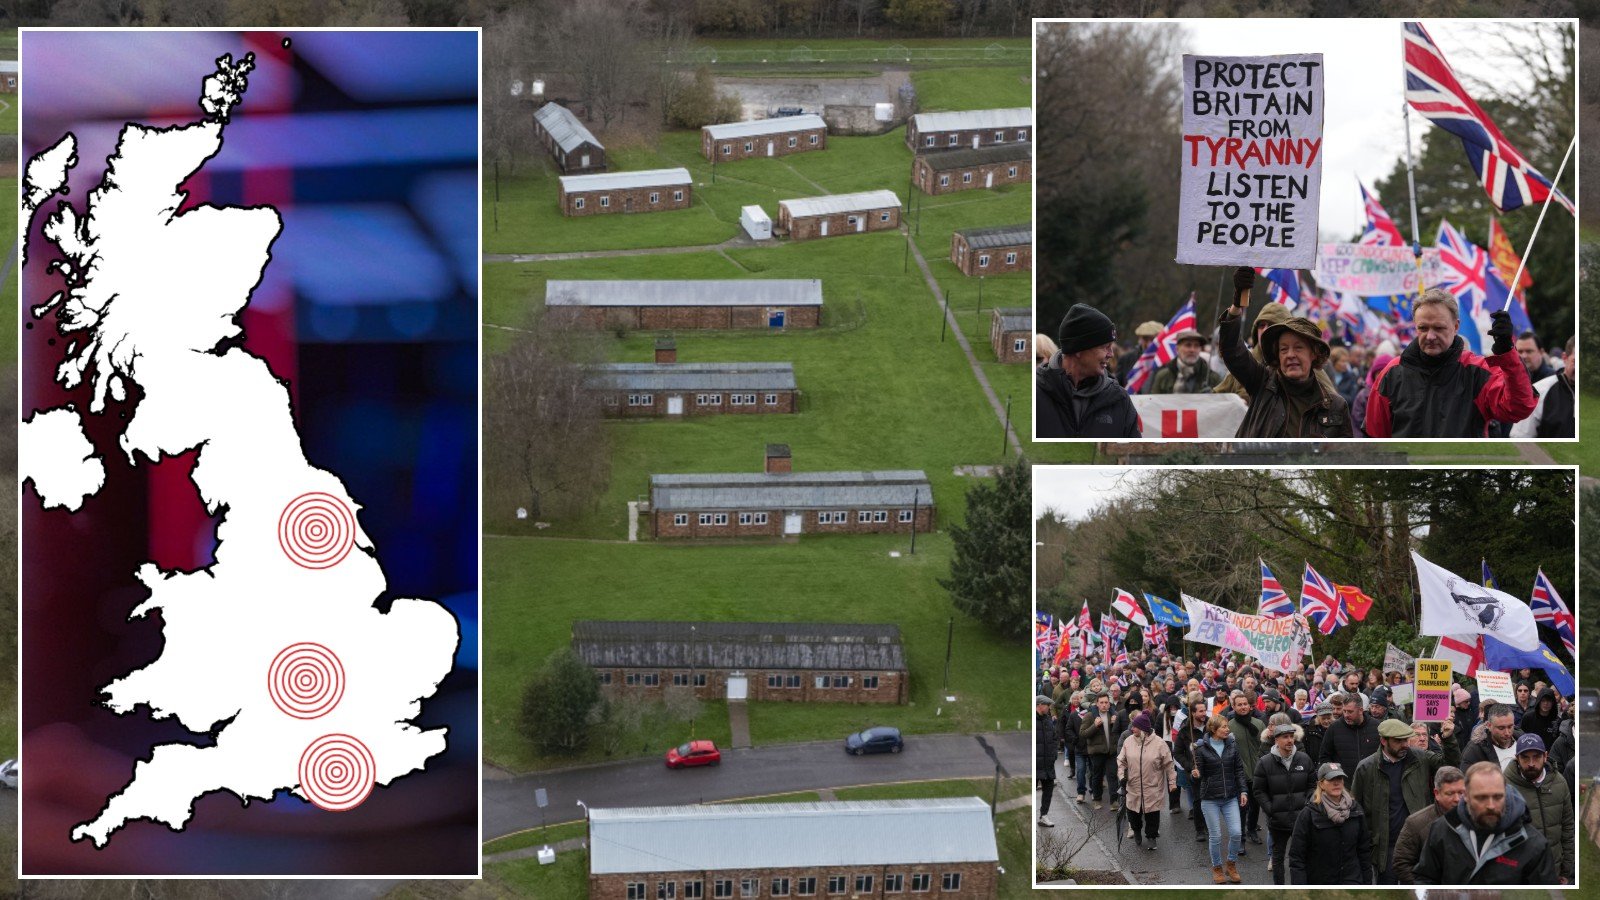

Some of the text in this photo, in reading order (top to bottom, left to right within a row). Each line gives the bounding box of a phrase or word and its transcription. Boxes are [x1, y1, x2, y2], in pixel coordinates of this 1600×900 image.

[1195, 60, 1320, 89] PROTECT
[1193, 90, 1313, 116] BRITAIN
[1228, 119, 1291, 139] FROM
[1184, 135, 1322, 170] TYRANNY
[1207, 172, 1308, 199] LISTEN
[1207, 201, 1295, 223] TO THE
[1197, 222, 1295, 247] PEOPLE
[1426, 707, 1437, 716] NO
